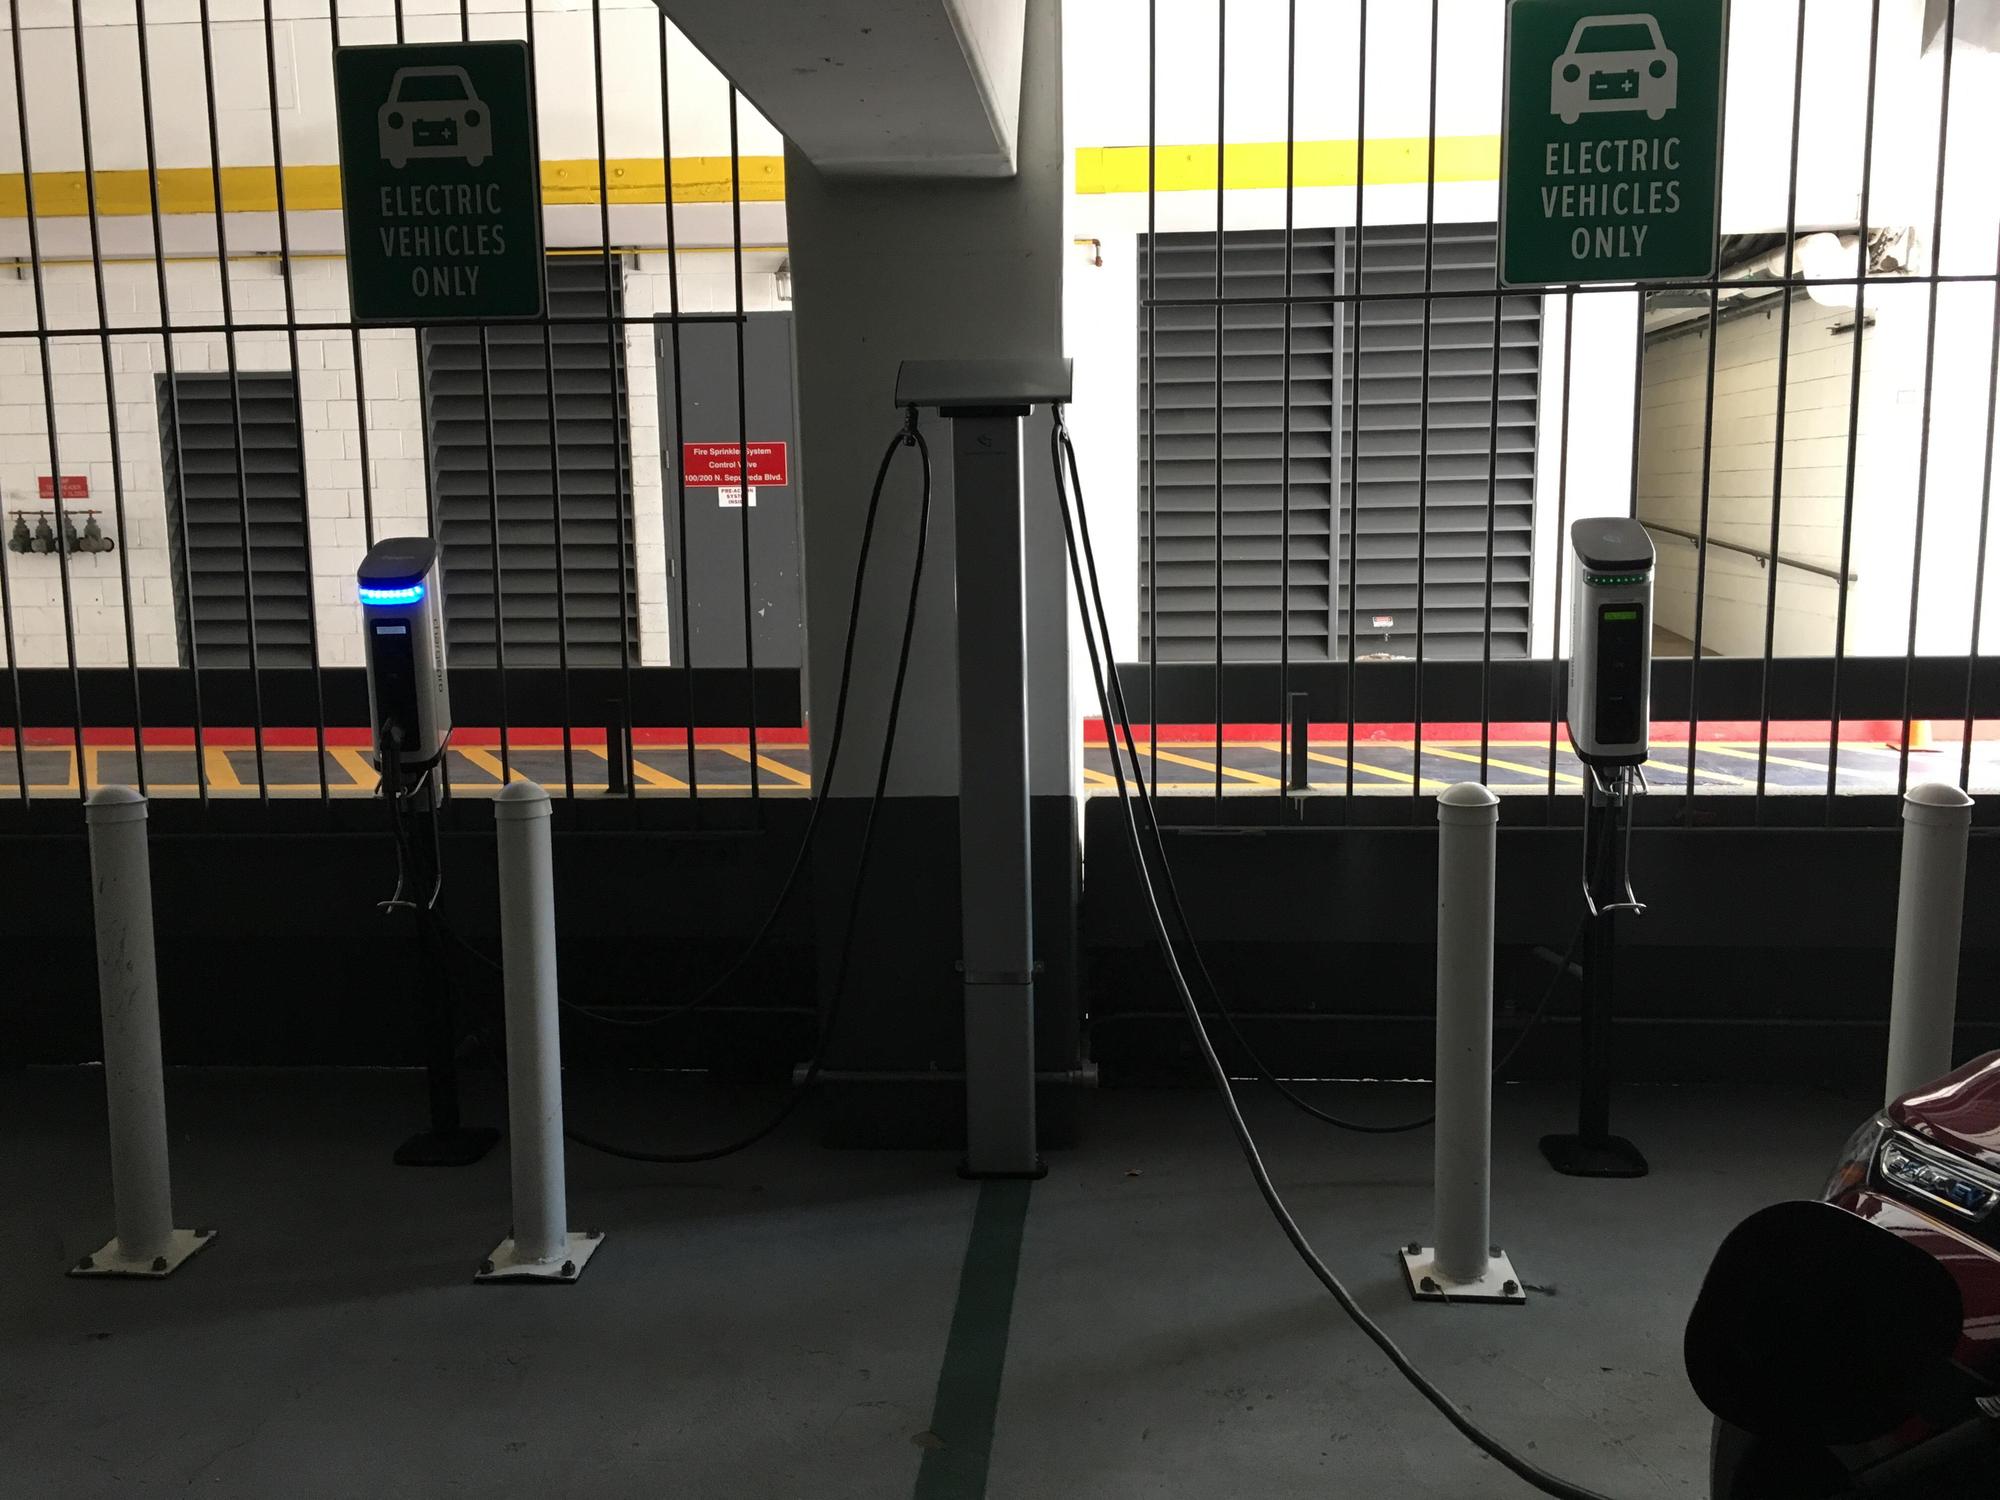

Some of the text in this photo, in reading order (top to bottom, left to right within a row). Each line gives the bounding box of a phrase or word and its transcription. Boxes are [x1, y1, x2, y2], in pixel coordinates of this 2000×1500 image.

[1545, 137, 1680, 175] ELECTRIC
[380, 183, 501, 217] ELECTRIC
[1541, 180, 1680, 218] VEHICLES
[379, 224, 506, 257] VEHICLES
[1571, 225, 1648, 260] ONLY
[412, 265, 480, 297] ONLY
[693, 447, 772, 457] Fire Sprinkle System
[708, 461, 758, 469] Control Vlve
[685, 474, 713, 482] 100/200
[724, 473, 763, 483] Sepueda
[764, 473, 783, 481] Blvd.
